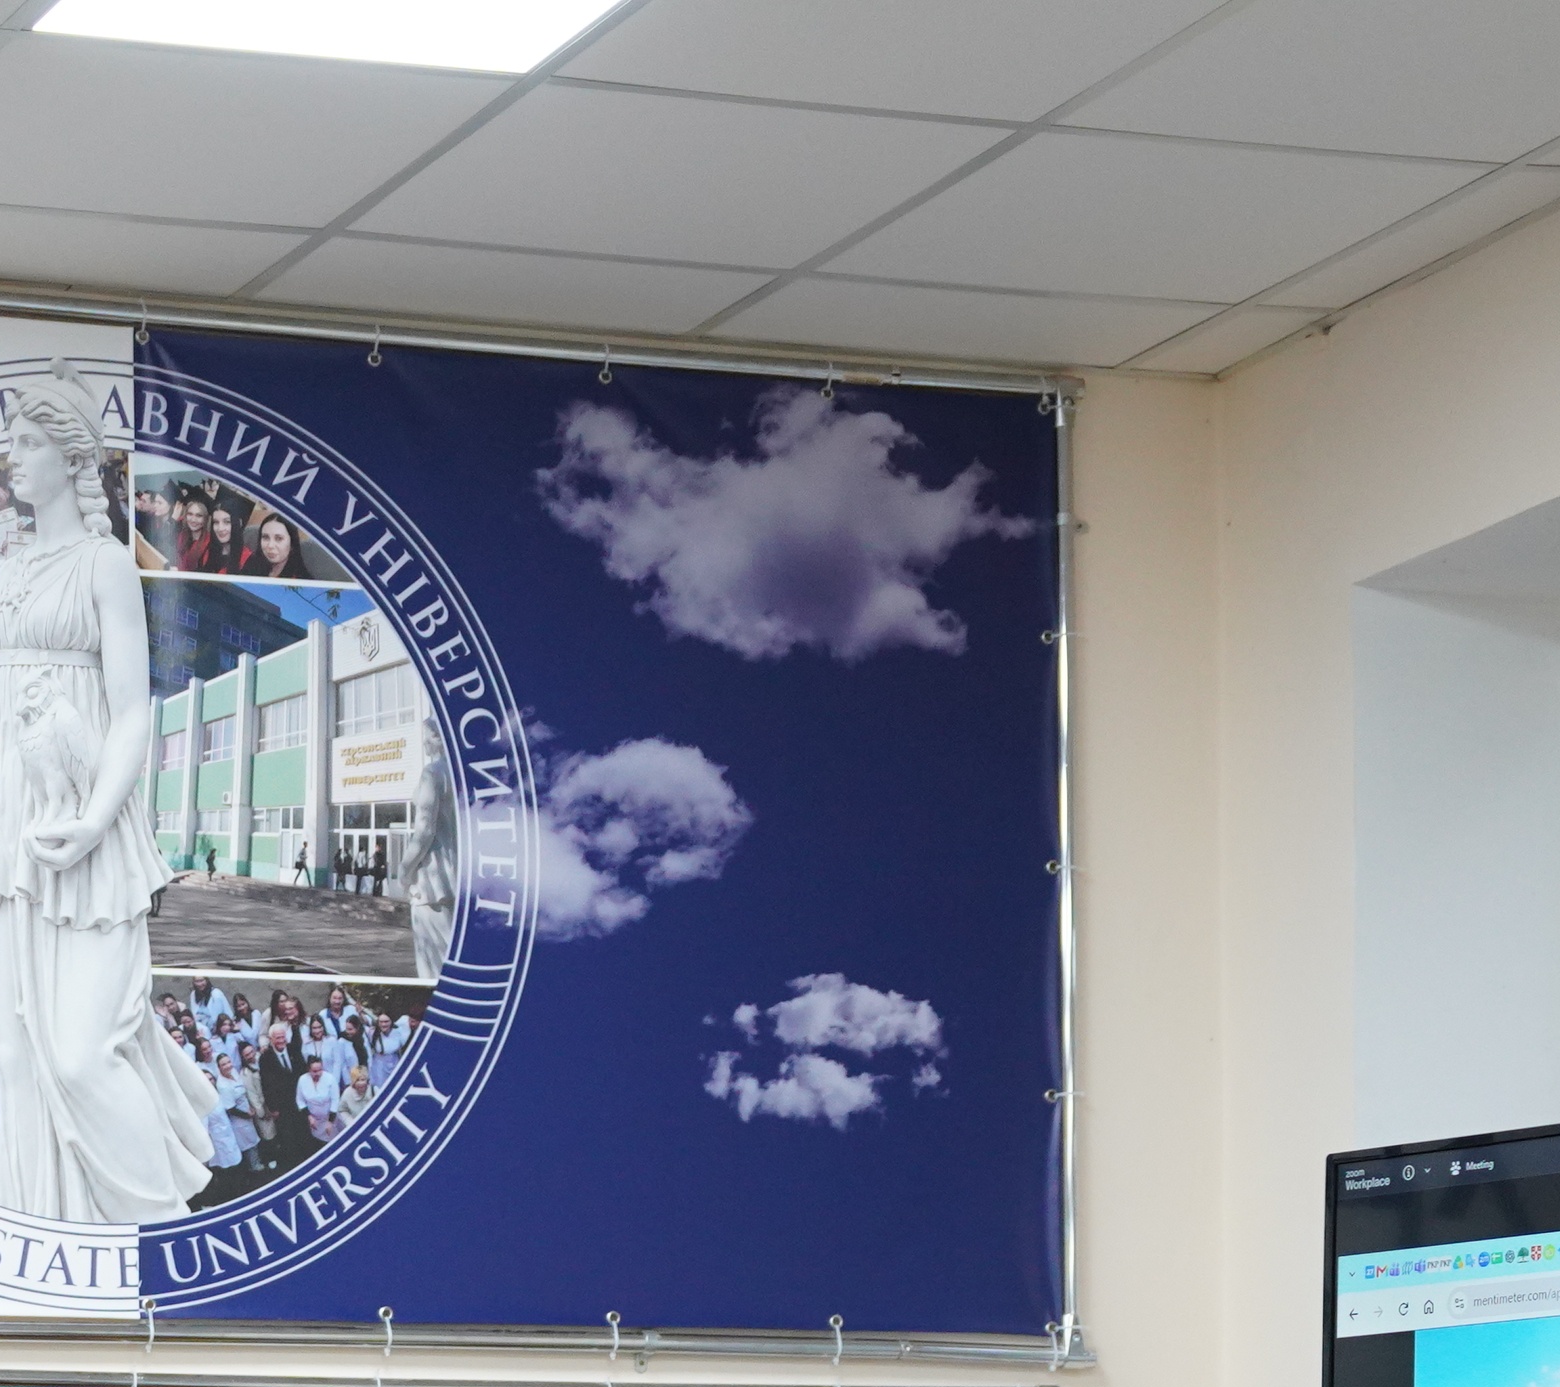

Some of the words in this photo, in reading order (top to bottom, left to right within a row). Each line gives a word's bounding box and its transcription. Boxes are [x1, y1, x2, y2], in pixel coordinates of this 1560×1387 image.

[332, 491, 517, 928] УНІВЕРСИТЕТ
[1345, 1169, 1365, 1179] zoom
[1465, 1158, 1495, 1173] Meeting
[160, 1069, 454, 1286] UNIVERSITY
[1345, 1175, 1391, 1192] Workplace
